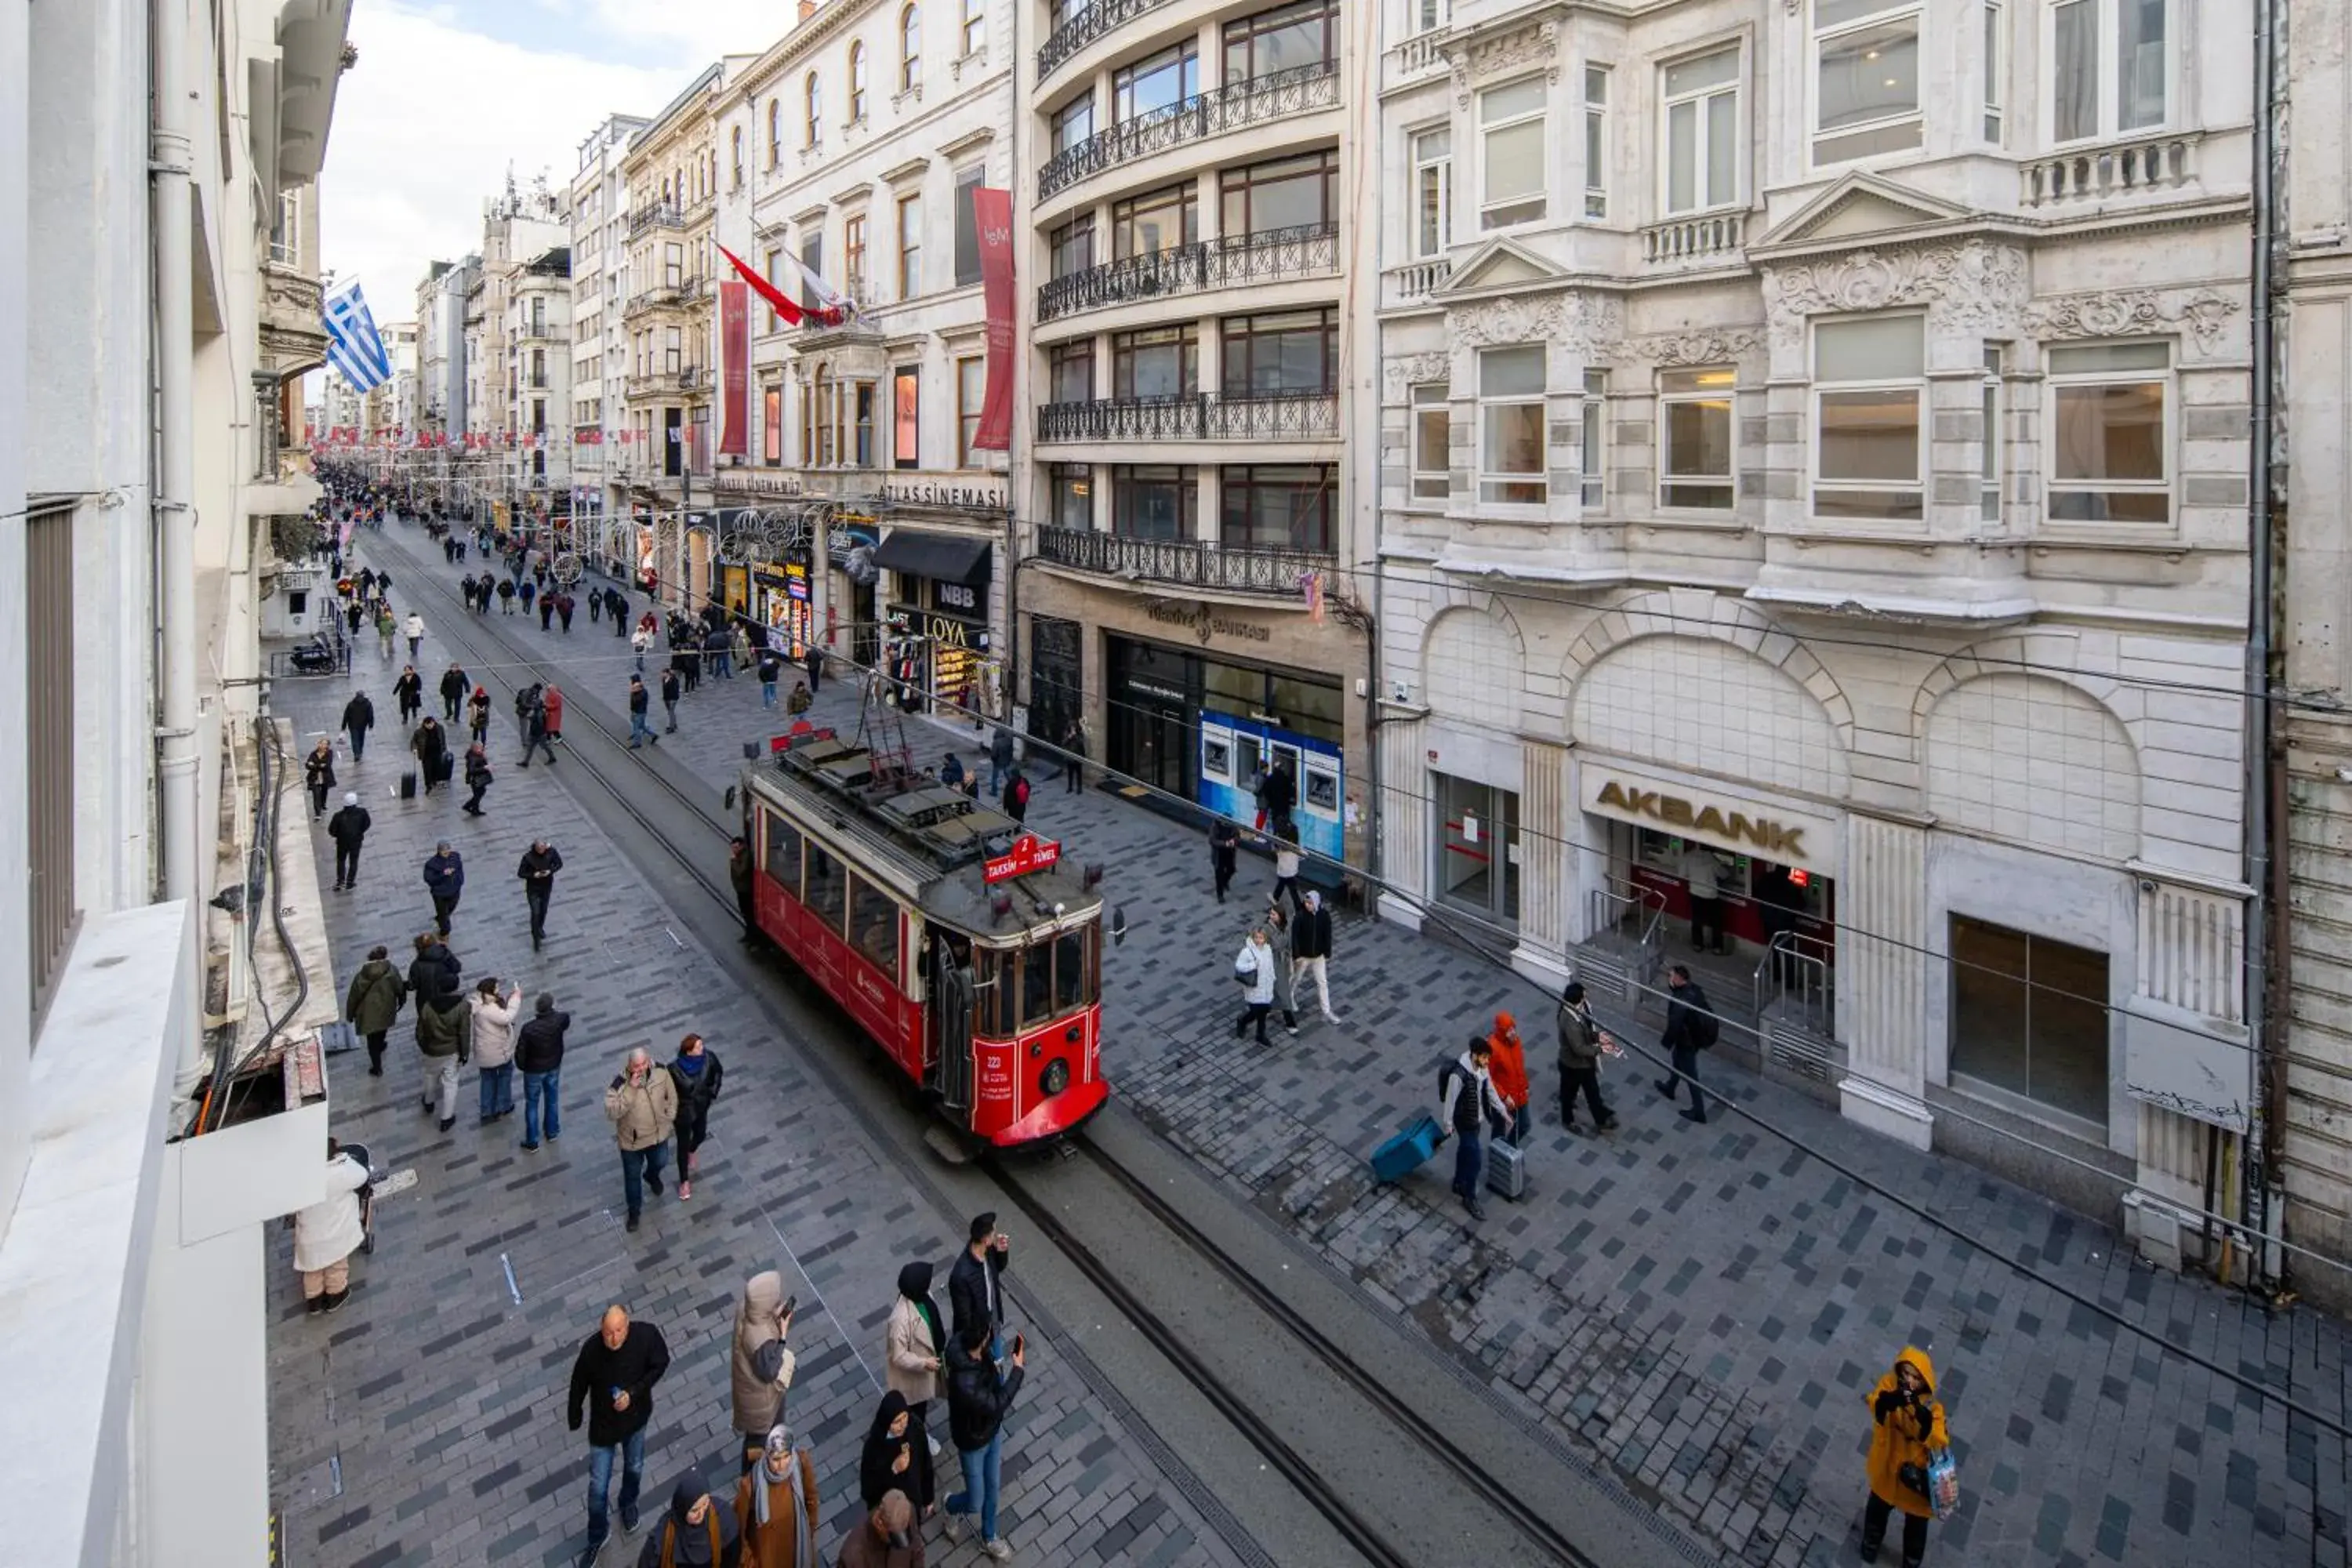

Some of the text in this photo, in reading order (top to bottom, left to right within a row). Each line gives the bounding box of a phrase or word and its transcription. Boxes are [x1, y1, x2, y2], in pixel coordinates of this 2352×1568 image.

[879, 482, 1004, 509] ATLAS SİNEMASI
[941, 583, 975, 608] NBB
[887, 610, 910, 626] LAST
[923, 614, 967, 647] LOYA
[1212, 618, 1270, 642] BANKASI
[1596, 781, 1808, 858] AKBANK
[1022, 839, 1029, 852] 2
[988, 859, 1017, 877] TAKSİM
[1033, 848, 1055, 866] TÜNEL
